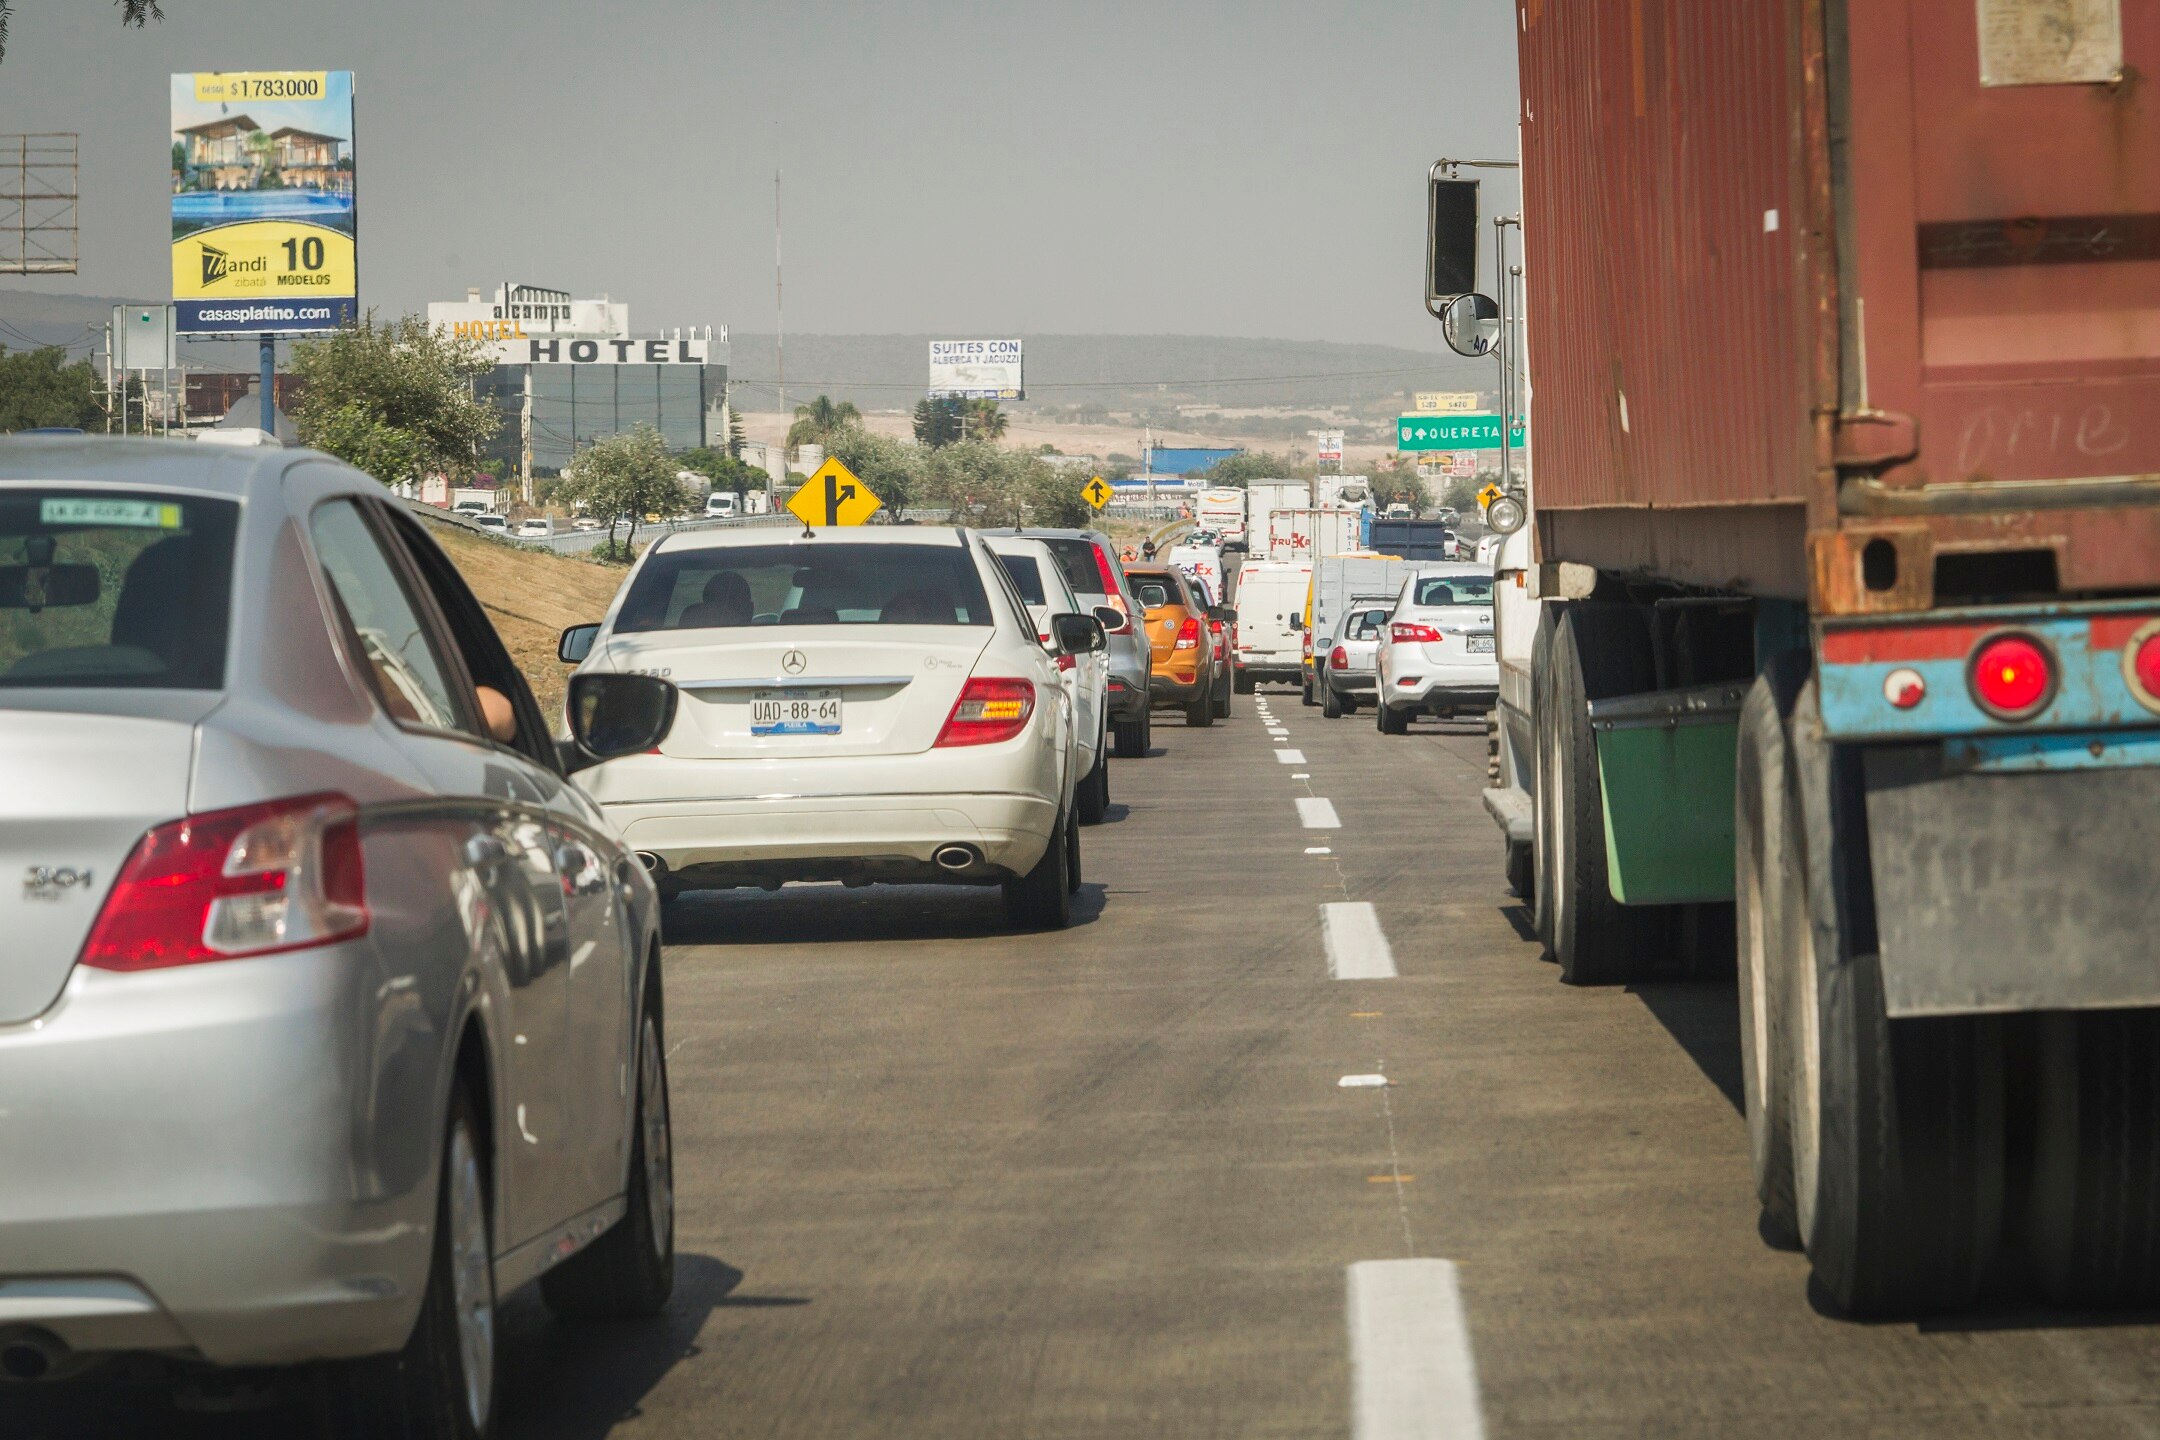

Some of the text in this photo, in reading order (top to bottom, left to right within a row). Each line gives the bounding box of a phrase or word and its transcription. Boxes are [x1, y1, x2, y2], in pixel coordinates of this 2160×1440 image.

[281, 236, 325, 272] 10
[277, 274, 331, 286] MODELOS
[198, 306, 331, 323] casasplatino.com
[493, 282, 569, 332] alcampo
[454, 319, 528, 341] HOTEL
[529, 339, 703, 363] HOTEL
[932, 341, 1019, 354] SUITES CON
[932, 354, 1020, 365] ALBERCA Y JACUZZI
[1429, 426, 1522, 439] QUERETAO
[1177, 562, 1213, 576] edEx
[753, 701, 837, 721] UAD-88-64
